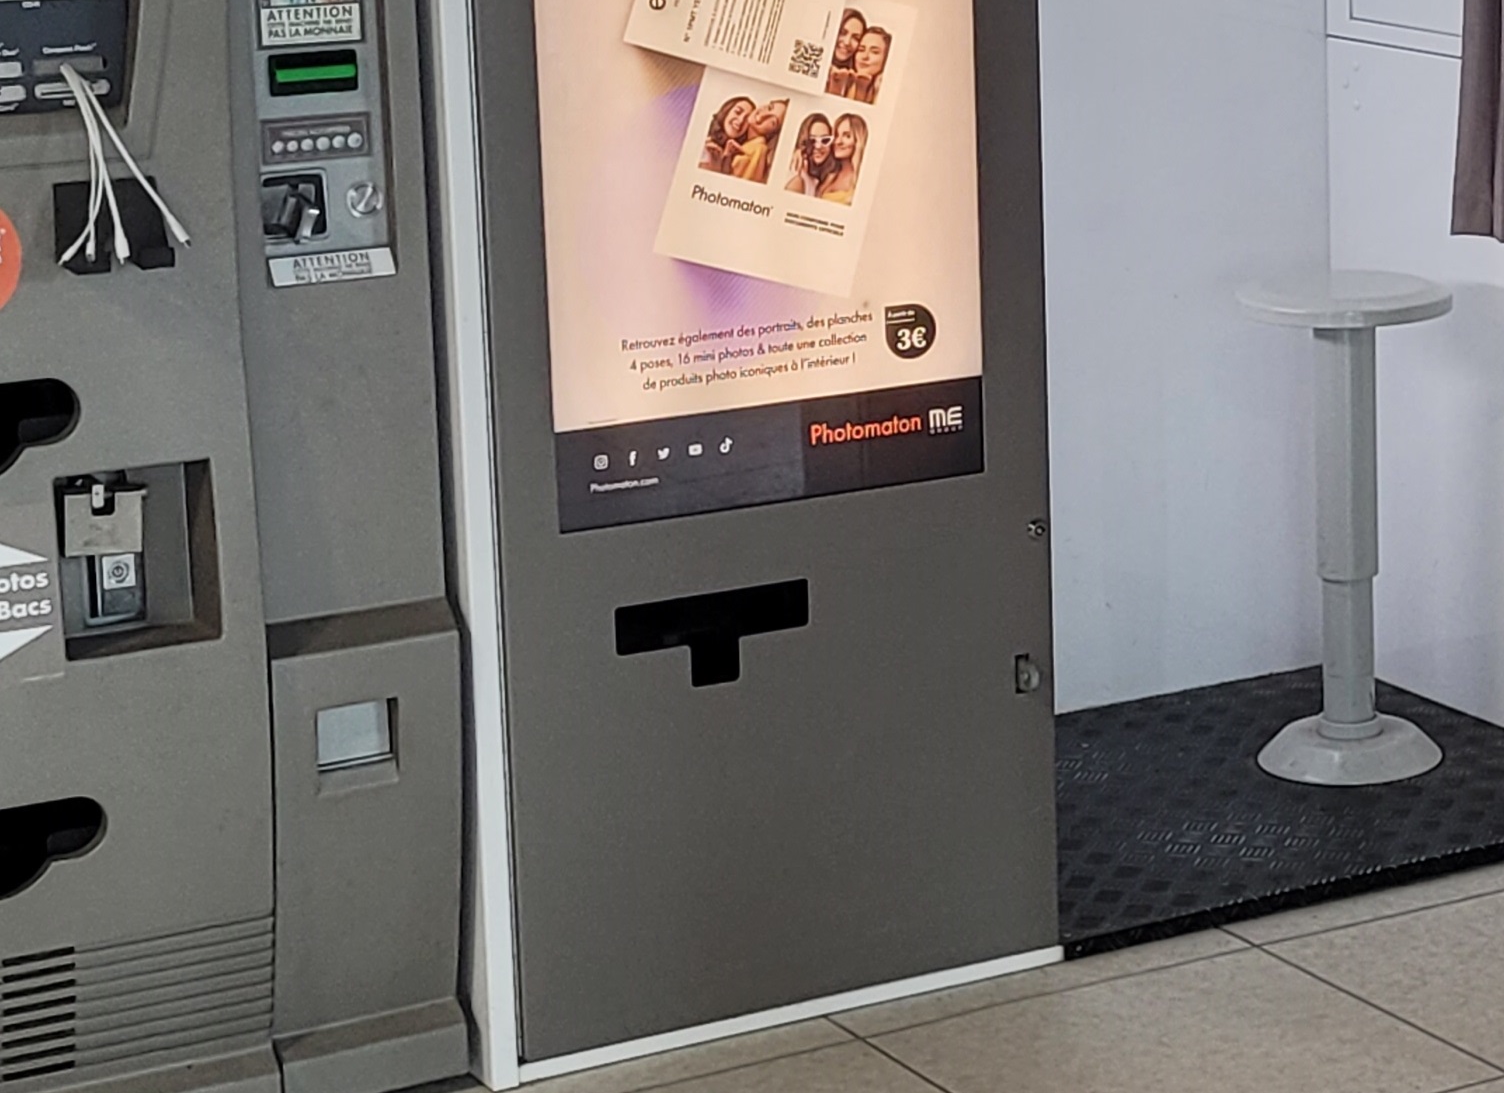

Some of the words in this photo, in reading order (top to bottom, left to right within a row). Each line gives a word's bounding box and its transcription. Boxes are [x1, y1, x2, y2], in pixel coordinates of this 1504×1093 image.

[267, 6, 353, 21] ATTENTION
[268, 29, 286, 39] PAS
[289, 28, 302, 37] LA
[304, 25, 353, 36] MONNAIE
[691, 184, 774, 218] Photomaton
[293, 252, 370, 269] ATTENTION
[621, 337, 676, 351] Retrouvez
[678, 328, 734, 348] également
[736, 325, 755, 338] des
[758, 319, 804, 338] portraits,
[806, 315, 825, 328] des
[827, 310, 873, 330] planches
[896, 326, 927, 351] 3€
[629, 359, 637, 371] 4
[640, 358, 674, 374] poses,
[678, 352, 691, 365] 16
[693, 349, 716, 363] mini
[718, 345, 754, 363] photos
[757, 343, 765, 355] &
[768, 342, 793, 354] toute
[796, 340, 816, 350] une
[819, 333, 867, 348] collection
[643, 377, 656, 390] de
[660, 373, 703, 391] produits
[705, 368, 737, 385] photo
[739, 363, 788, 378] iconiques
[791, 359, 798, 371] à
[810, 412, 922, 446] Photomaton
[928, 406, 963, 429] ME
[0, 599, 52, 621] Bacs
